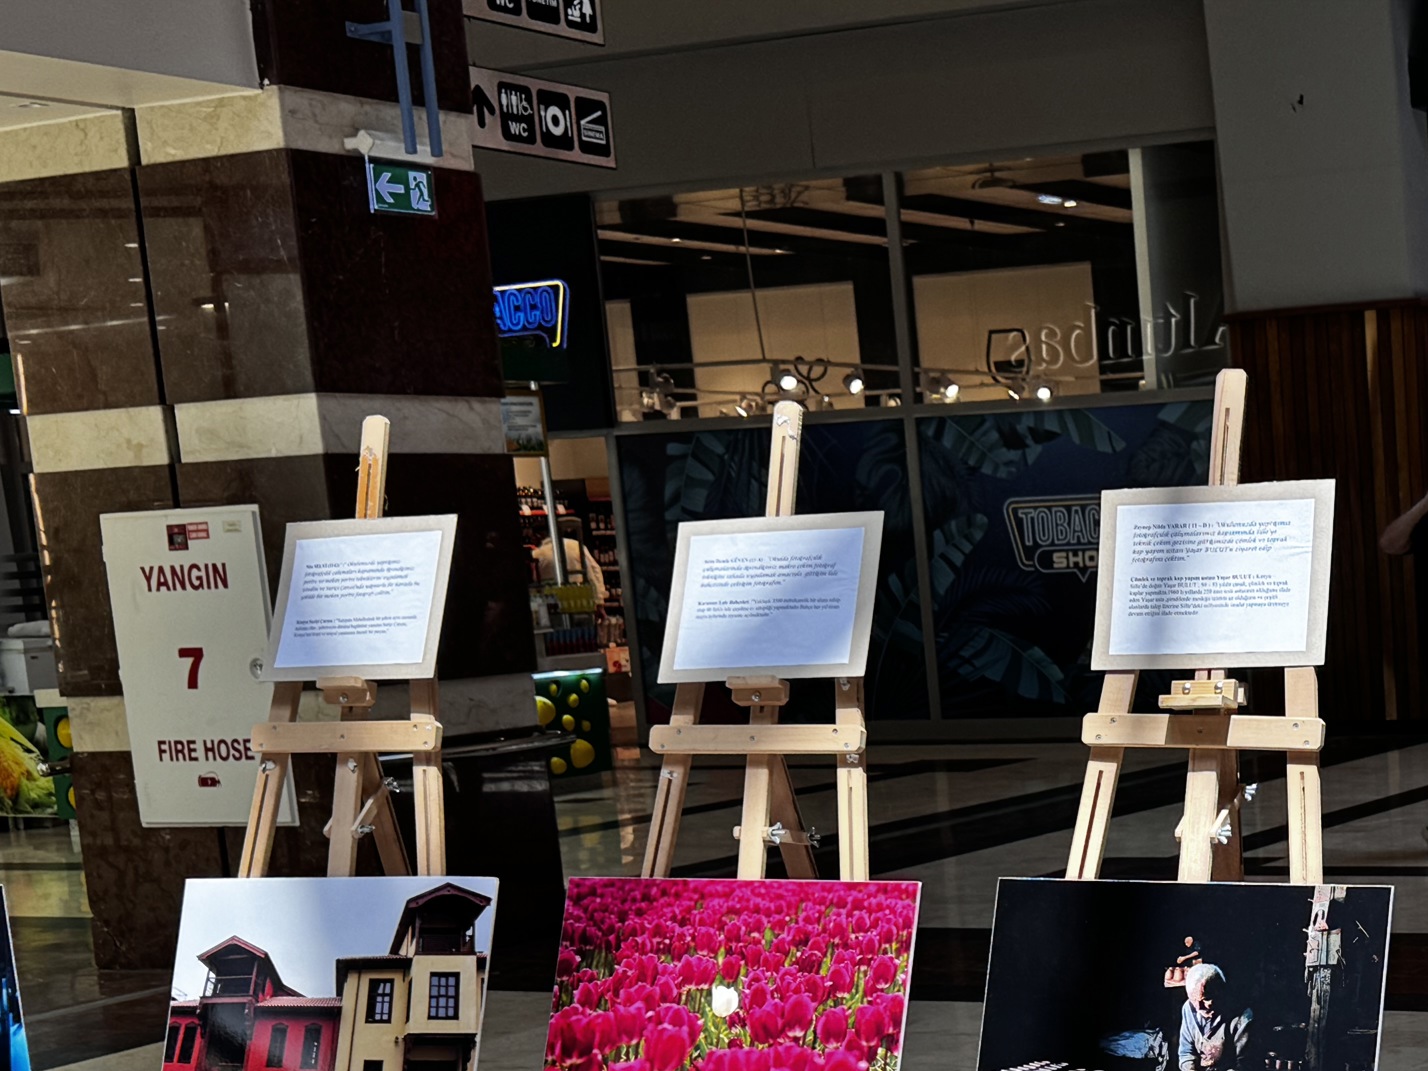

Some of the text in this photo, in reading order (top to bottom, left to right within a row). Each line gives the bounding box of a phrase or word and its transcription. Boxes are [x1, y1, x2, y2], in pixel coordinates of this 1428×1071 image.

[509, 121, 528, 137] WC
[140, 562, 229, 592] YANGIN
[178, 647, 204, 690] 7
[157, 738, 255, 763] FIRE HOSE
